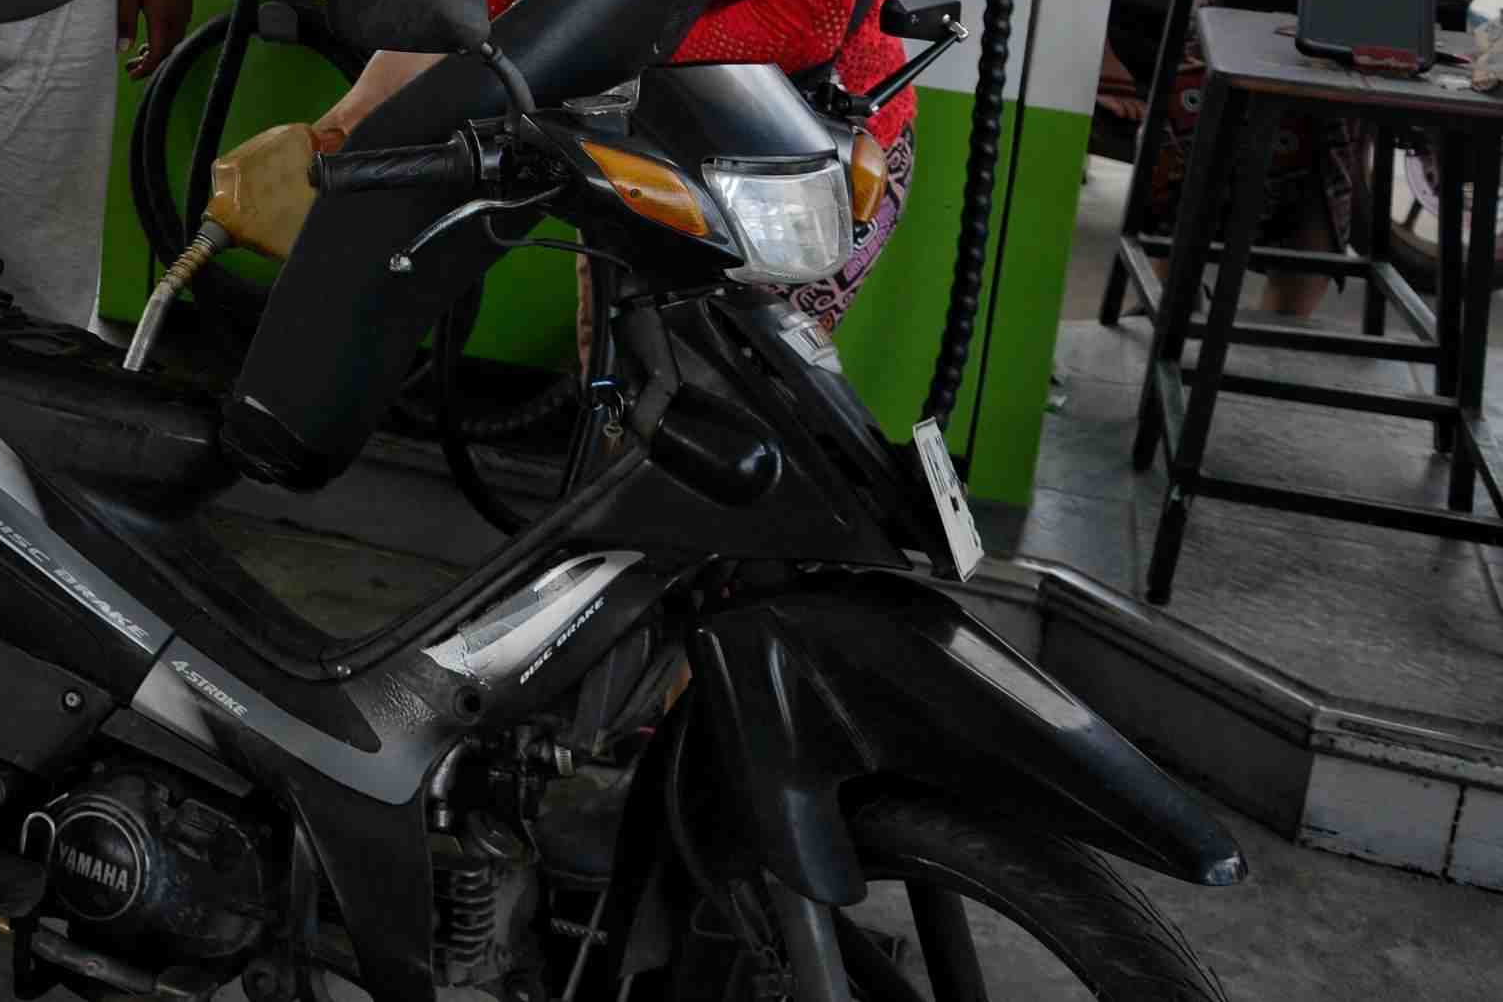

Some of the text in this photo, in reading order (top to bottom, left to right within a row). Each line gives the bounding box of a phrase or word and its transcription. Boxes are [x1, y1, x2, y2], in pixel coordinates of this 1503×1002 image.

[55, 568, 149, 639] BRAKE
[520, 597, 605, 685] DISC BRAKE
[172, 660, 248, 719] 4-STROKE
[59, 841, 128, 892] YAMAHA
